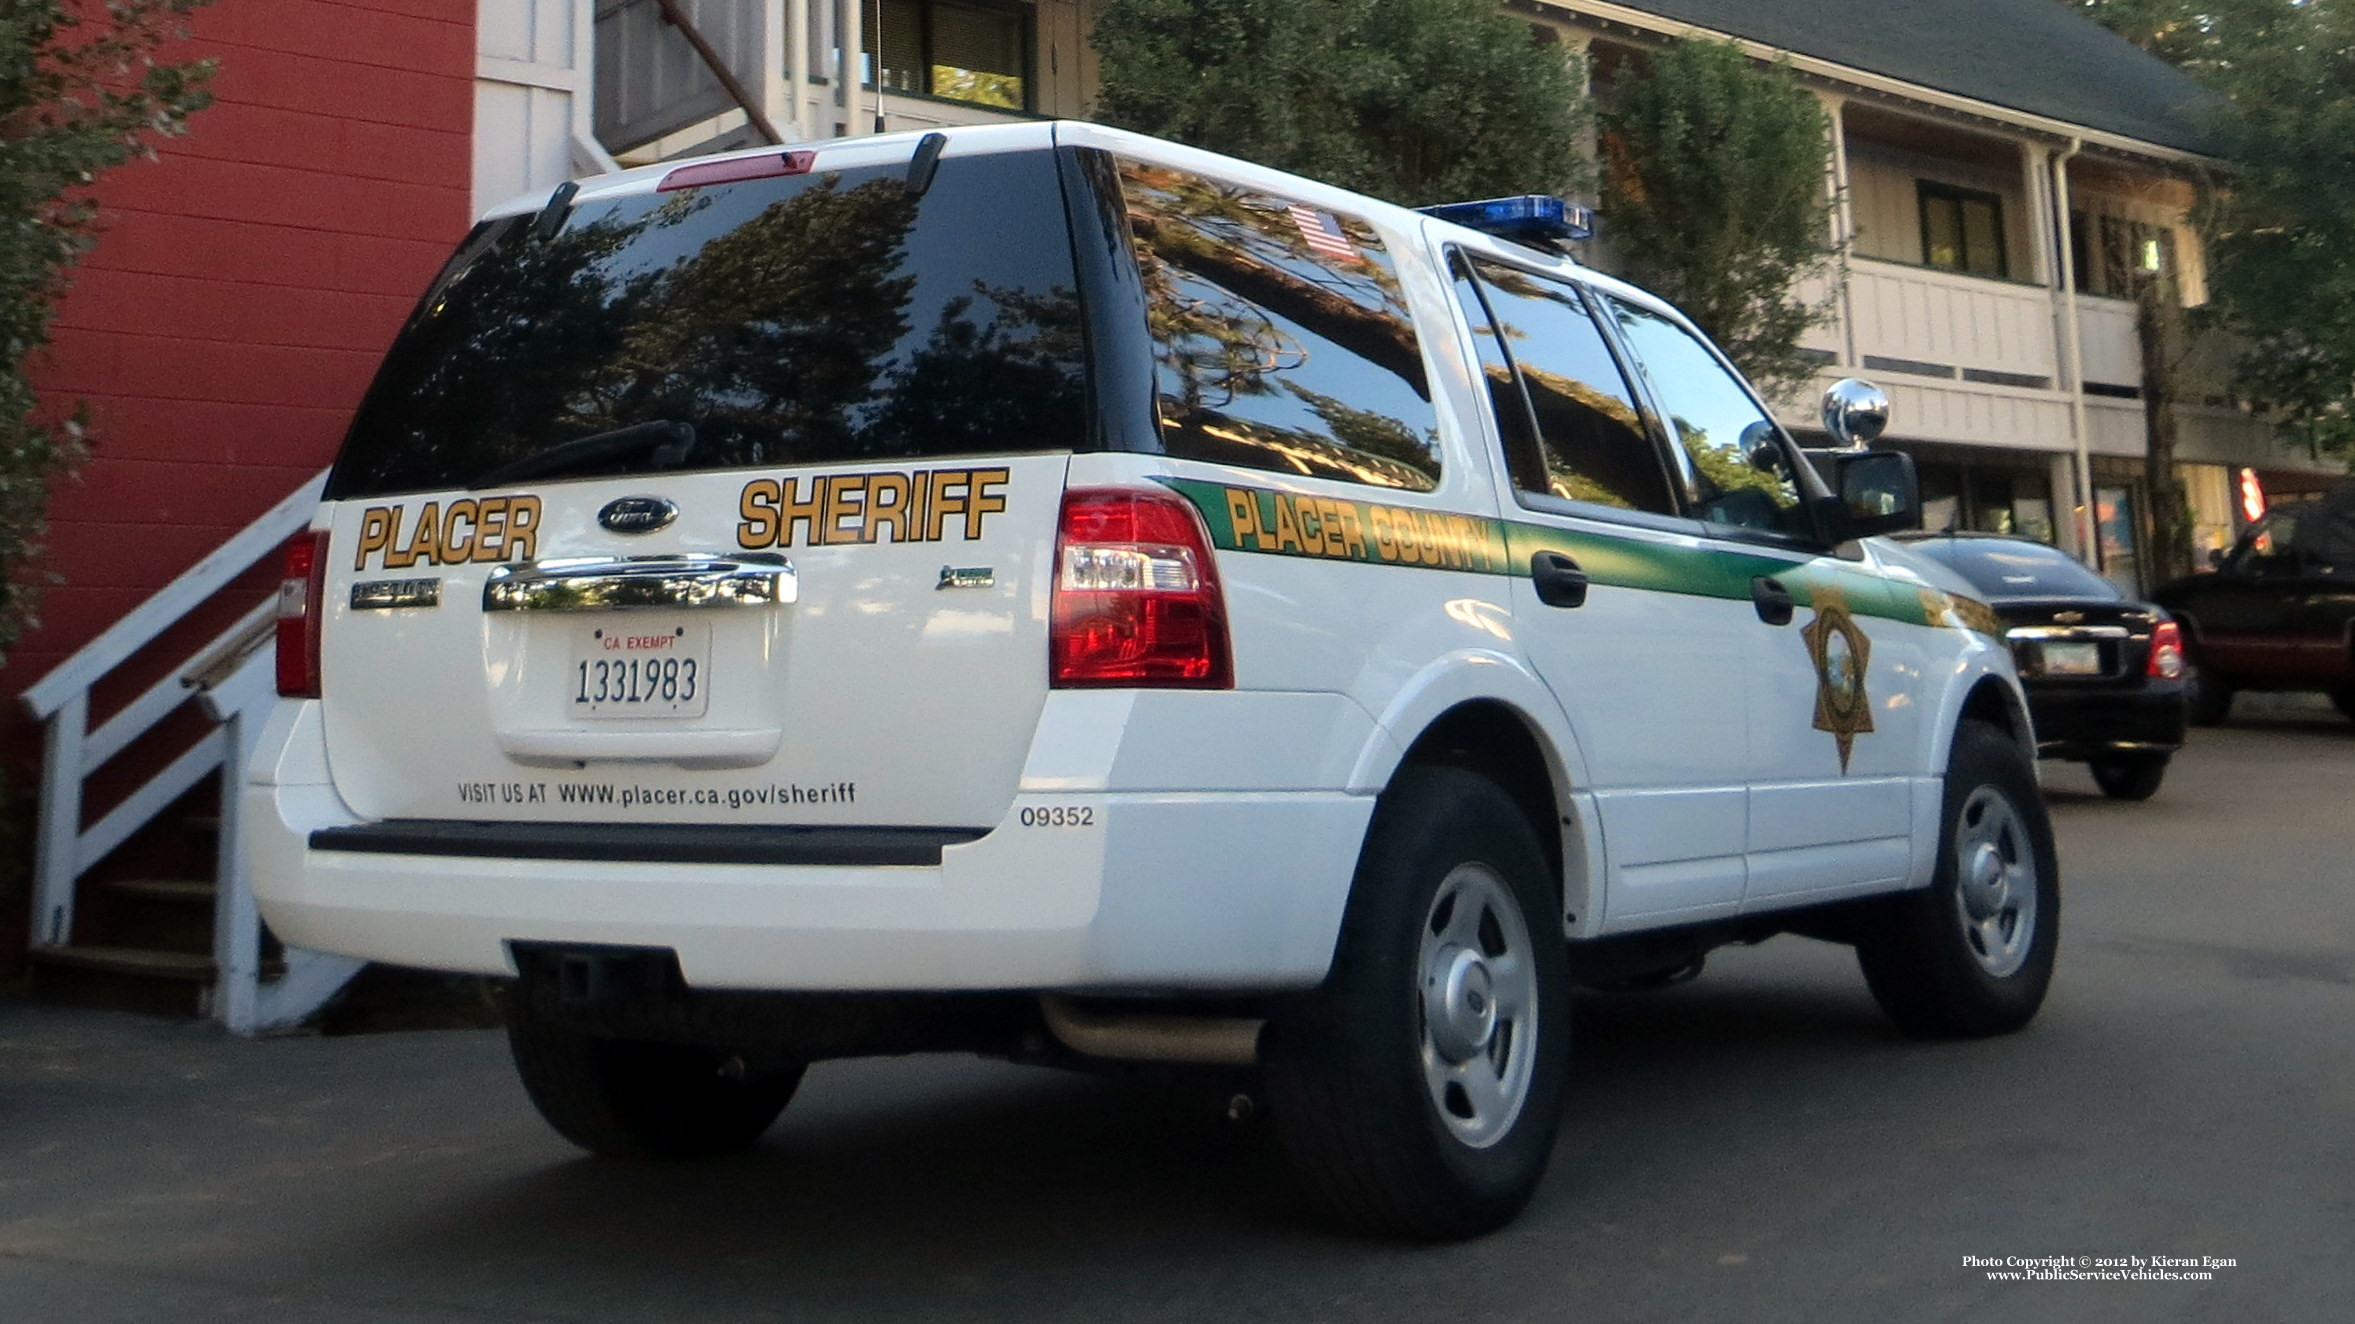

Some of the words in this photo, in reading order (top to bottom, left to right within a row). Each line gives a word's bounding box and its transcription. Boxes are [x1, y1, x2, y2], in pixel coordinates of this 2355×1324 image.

[354, 495, 542, 571] PLACER
[736, 467, 1010, 550] SHERIFF
[1225, 487, 1367, 558] PLACER
[1369, 504, 1492, 571] COUNTY
[604, 637, 620, 650] CA
[627, 636, 676, 649] EXEMPT
[575, 657, 697, 703] 1331983
[458, 783, 496, 802] VISIT
[502, 783, 523, 803] US
[529, 783, 545, 803] AT
[557, 782, 856, 809] WWW.placer.ca.gov/sheriff
[1020, 807, 1094, 826] 09352
